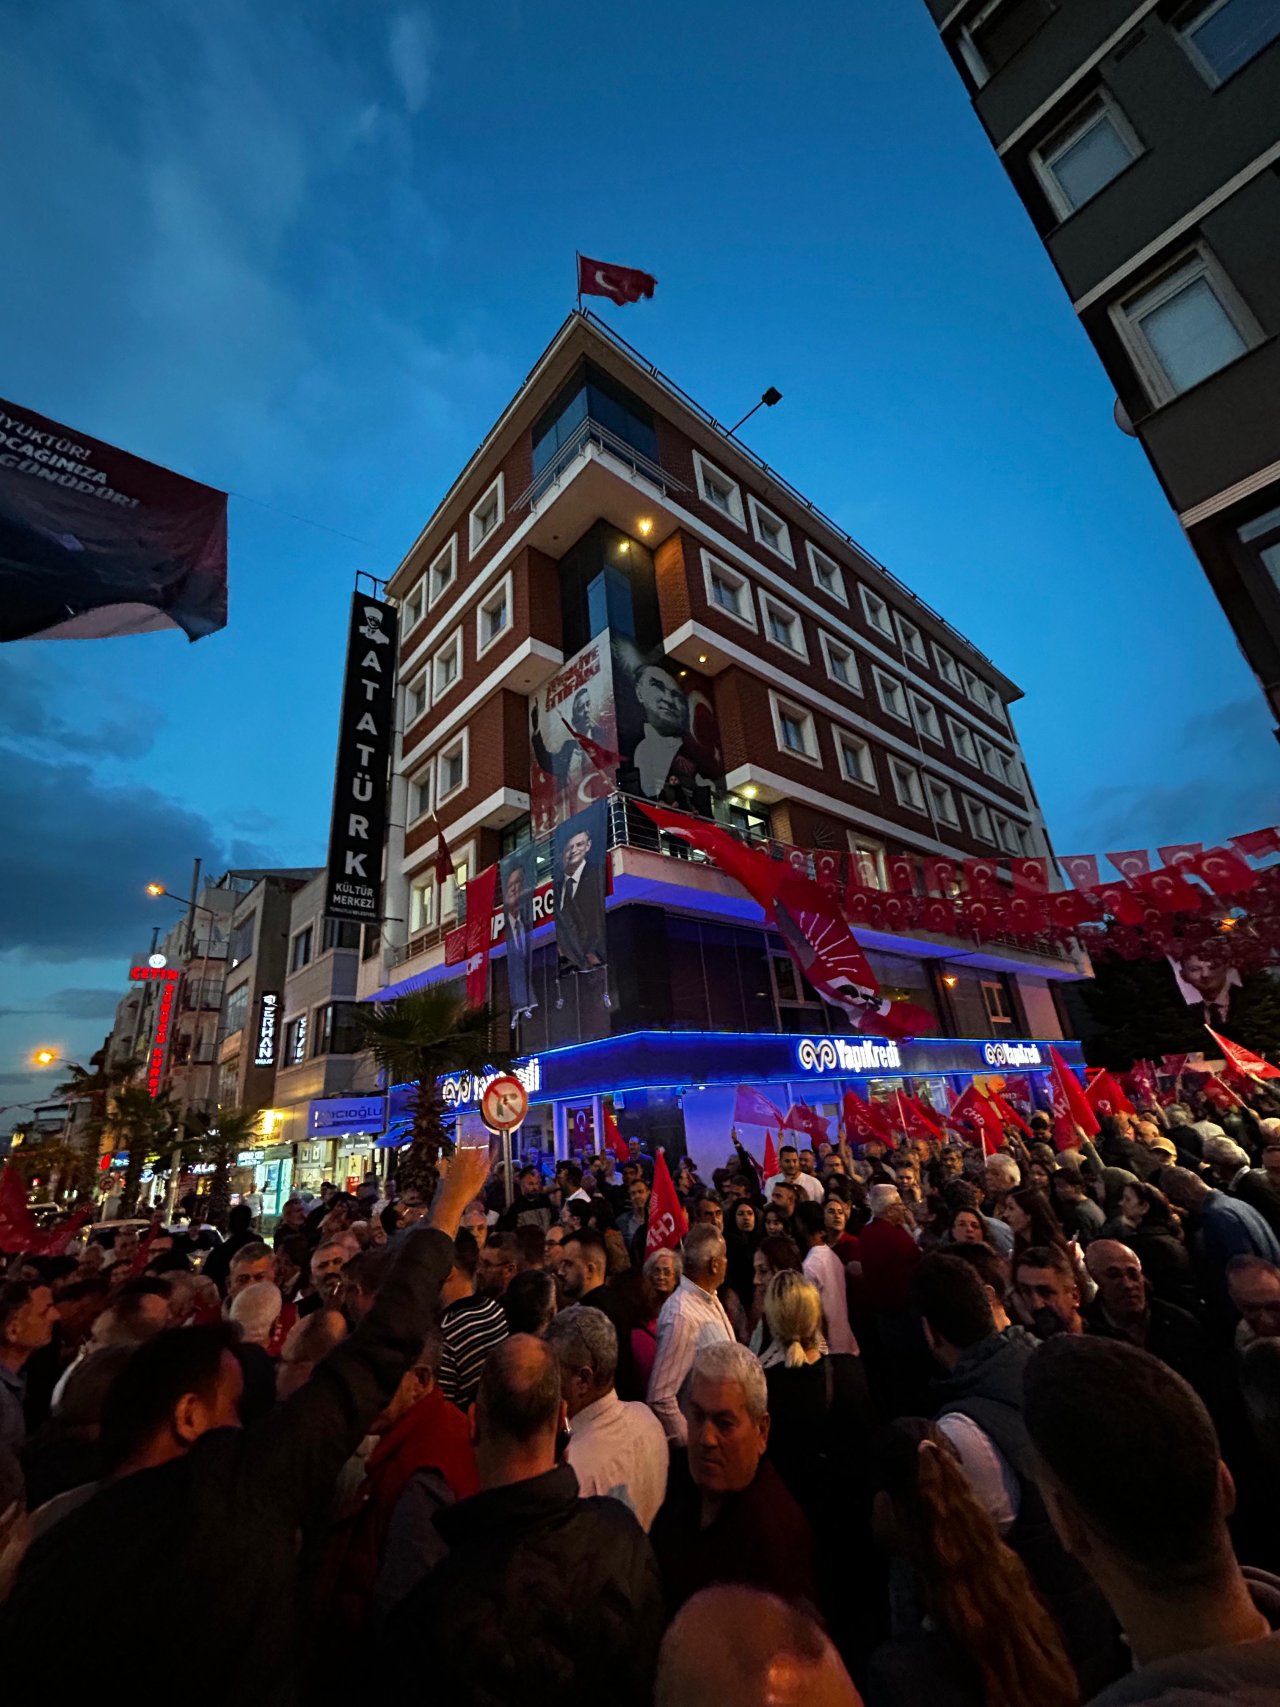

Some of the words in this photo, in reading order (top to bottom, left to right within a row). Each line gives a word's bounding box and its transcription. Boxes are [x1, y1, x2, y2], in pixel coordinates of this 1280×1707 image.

[344, 650, 382, 878] ATATÜRK
[335, 881, 374, 897] KÜLTÜR
[333, 894, 375, 909] MERKEZİ
[962, 1107, 985, 1126] CHP
